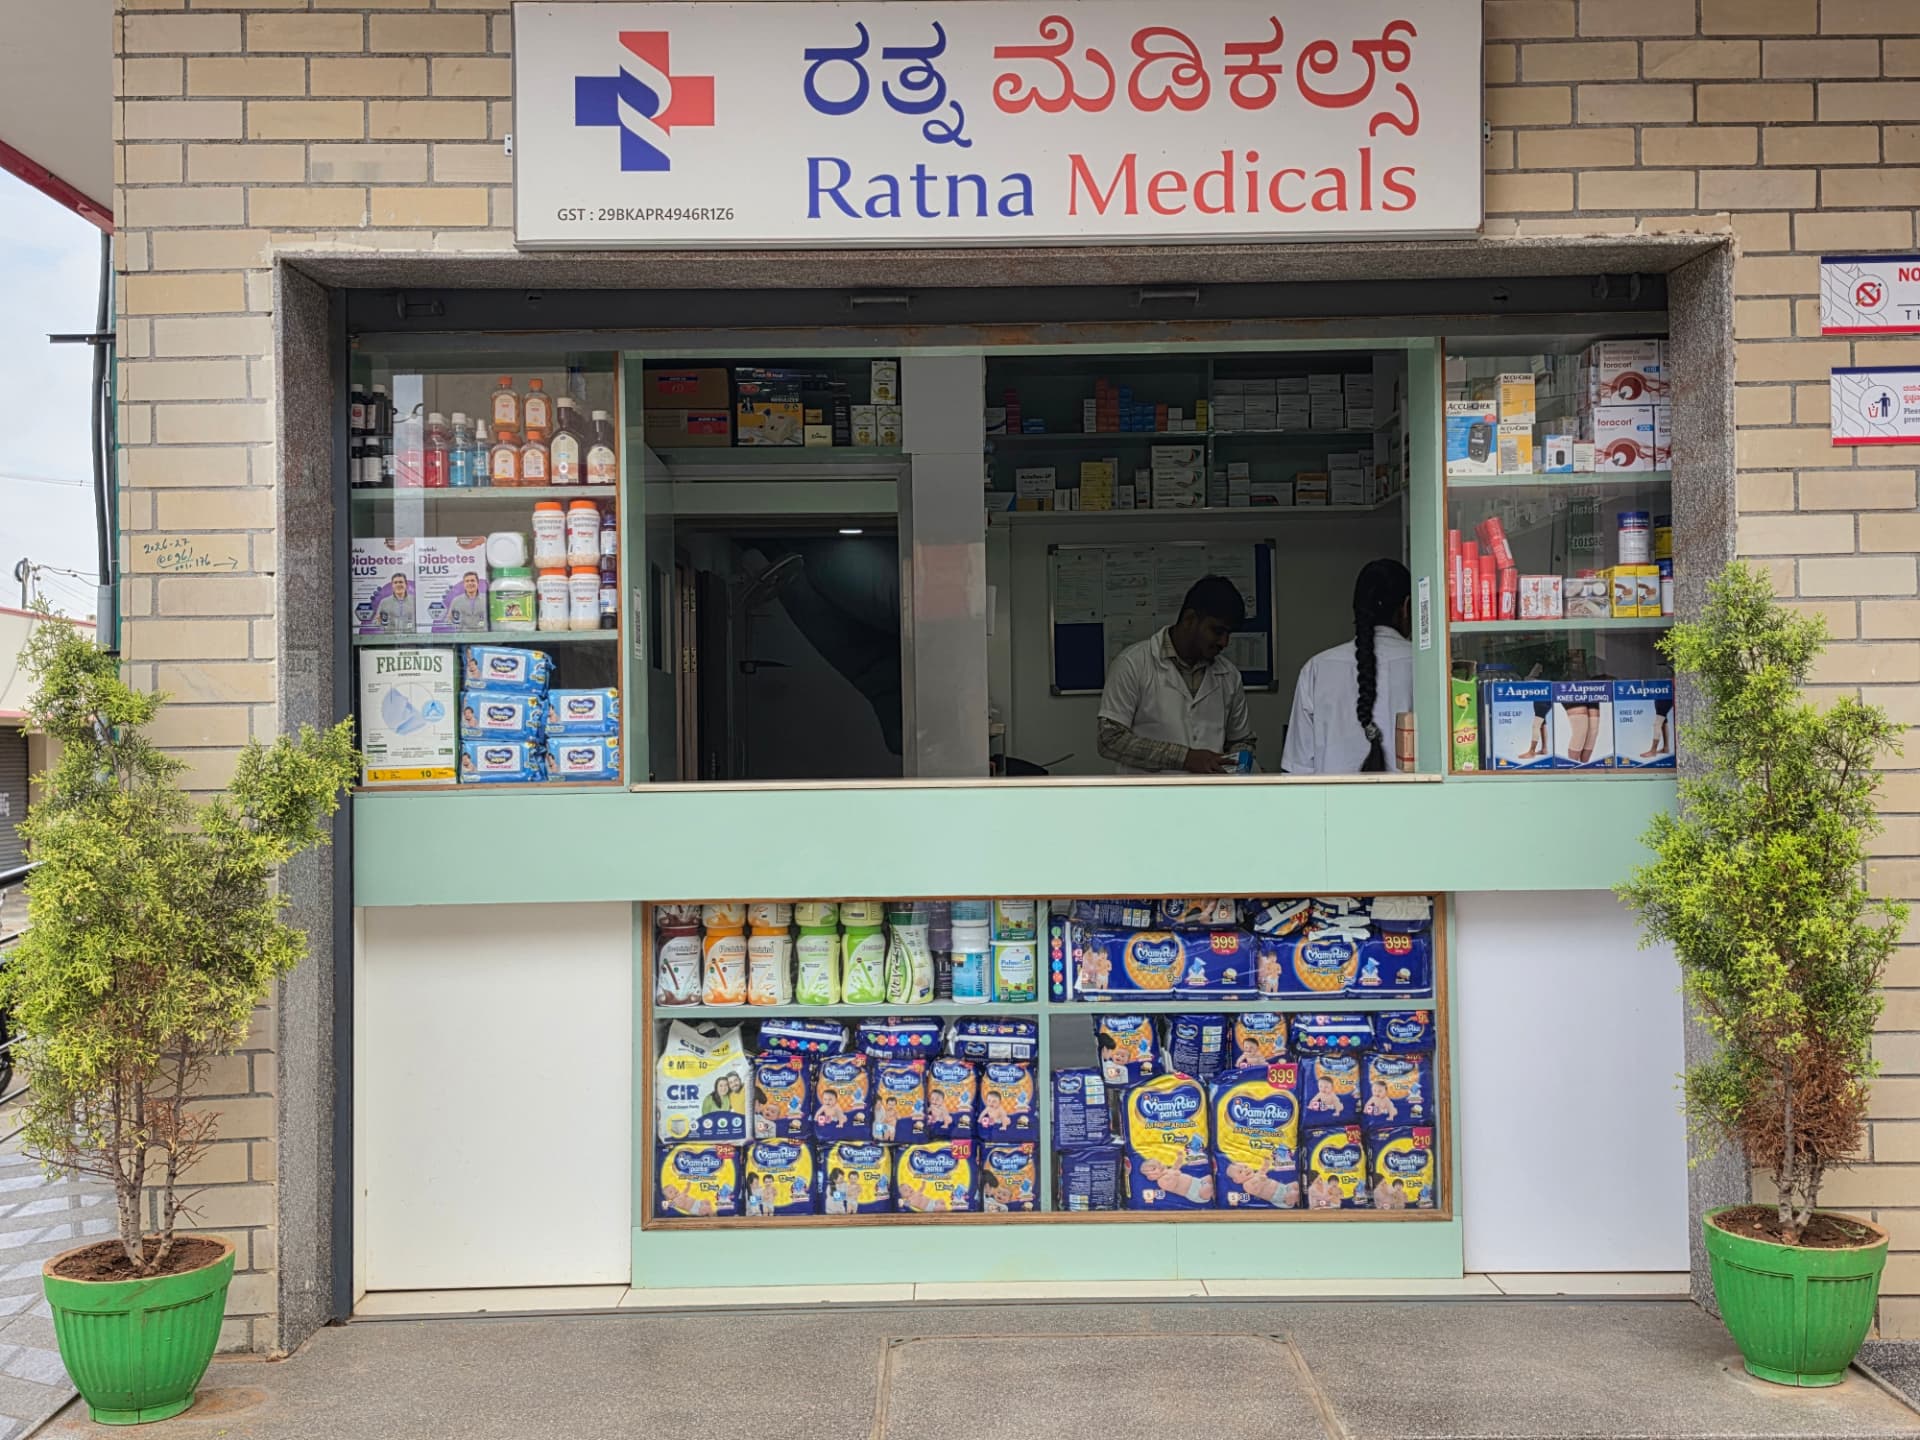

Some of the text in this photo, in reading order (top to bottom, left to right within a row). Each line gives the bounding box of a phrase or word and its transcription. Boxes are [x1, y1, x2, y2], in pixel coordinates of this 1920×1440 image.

[803, 15, 1420, 148] ರತ್ನ ಮೆಡಿಕಲ್ಸ್
[806, 147, 1417, 219] Ratna Medicals
[557, 208, 585, 222] GST
[598, 207, 735, 222] 29BKAPR4946R1Z6
[1597, 418, 1632, 427] foracort
[418, 553, 475, 564] Diabetes
[352, 566, 378, 576] LUS
[418, 565, 449, 575] PLUS
[376, 655, 443, 674] FRIENDS
[1506, 686, 1549, 699] Aapson
[1568, 683, 1606, 694] Aapson
[1626, 685, 1670, 697] Aapson
[1588, 694, 1609, 702] (LONG)
[420, 769, 433, 778] 10
[1212, 936, 1238, 950] 399
[1385, 936, 1411, 950] 399
[1269, 1069, 1294, 1084] 399
[666, 1084, 700, 1101] CIR
[1142, 1096, 1197, 1114] MamyPoko
[1233, 1103, 1288, 1119] MamyPoko
[1160, 1109, 1183, 1119] pants
[1248, 1117, 1272, 1127] pants
[1163, 1133, 1174, 1143] 12
[1413, 1136, 1431, 1145] 210
[952, 1145, 969, 1156] 210
[1250, 1140, 1260, 1149] 12
[757, 1147, 797, 1159] MamyPoko
[678, 1156, 721, 1169] MamyPoko
[915, 1153, 955, 1168] MamyPoko
[935, 1182, 944, 1191] 12
